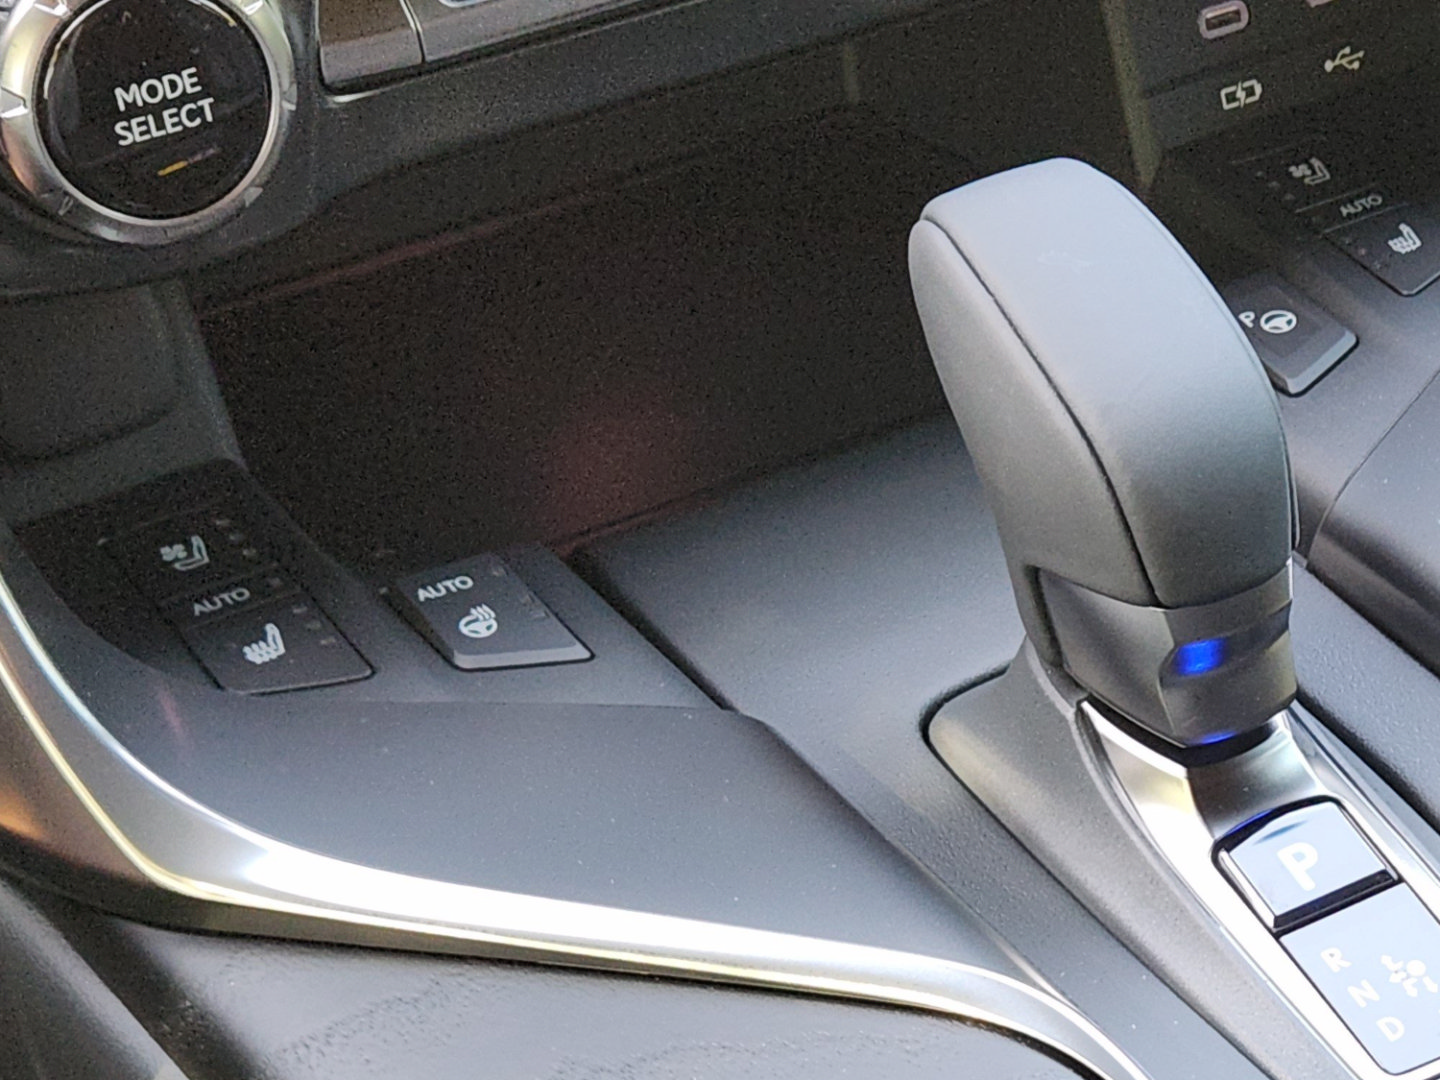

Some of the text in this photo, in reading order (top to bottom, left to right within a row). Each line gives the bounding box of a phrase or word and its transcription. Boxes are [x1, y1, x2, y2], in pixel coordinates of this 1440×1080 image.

[115, 67, 202, 111] MODE
[113, 97, 214, 146] SELECT
[1339, 194, 1383, 217] AUTO
[193, 587, 250, 617] AUTO
[417, 575, 473, 603] AUTO
[1277, 842, 1319, 890] P
[1320, 947, 1351, 972] R
[1347, 980, 1379, 1010] N
[1377, 1016, 1404, 1042] D
